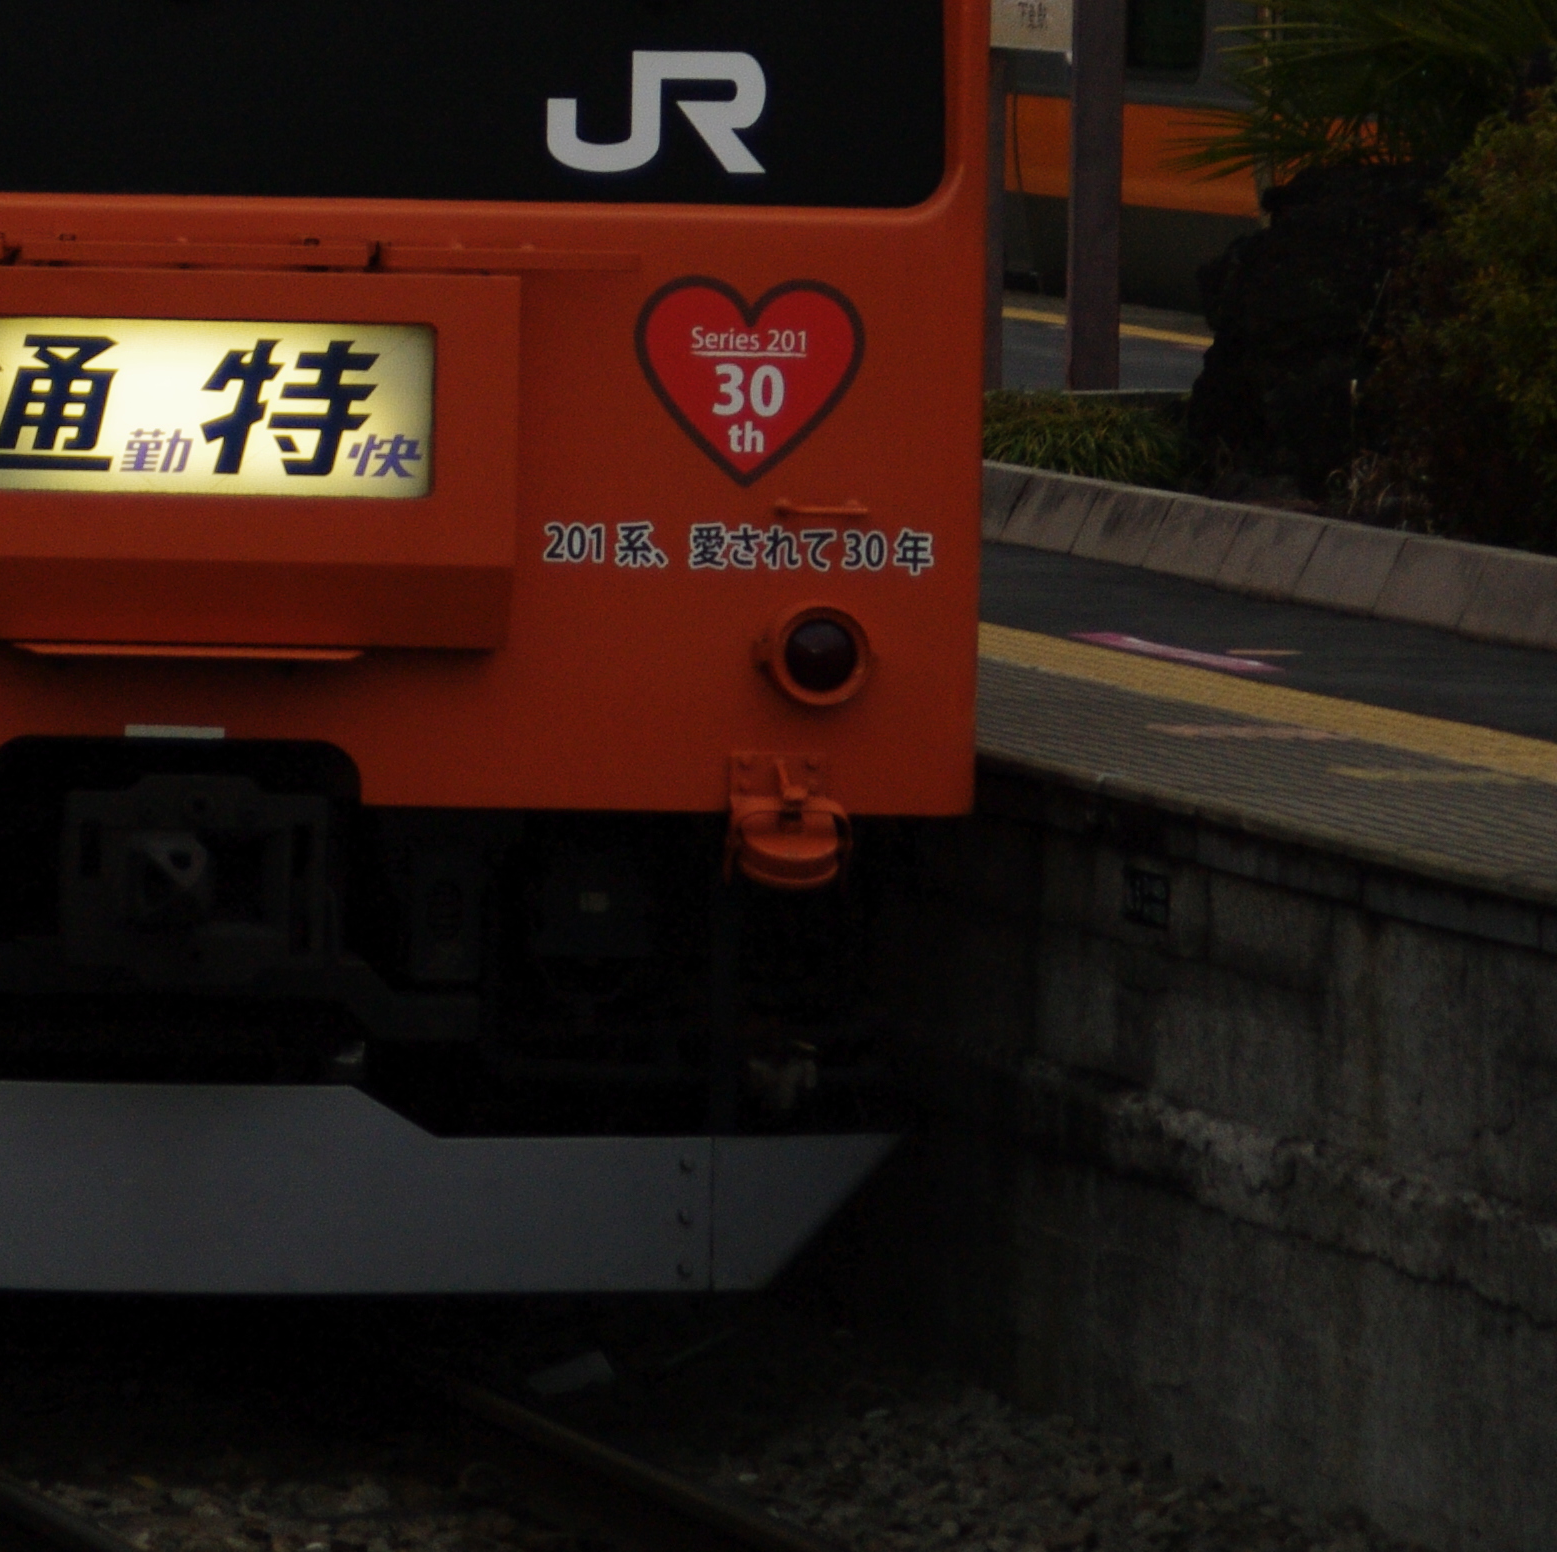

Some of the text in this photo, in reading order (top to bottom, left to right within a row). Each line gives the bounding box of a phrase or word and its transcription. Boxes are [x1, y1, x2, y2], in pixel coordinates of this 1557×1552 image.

[546, 50, 767, 174] JR
[691, 326, 808, 353] Series 201
[711, 363, 785, 417] 30
[727, 420, 765, 454] th
